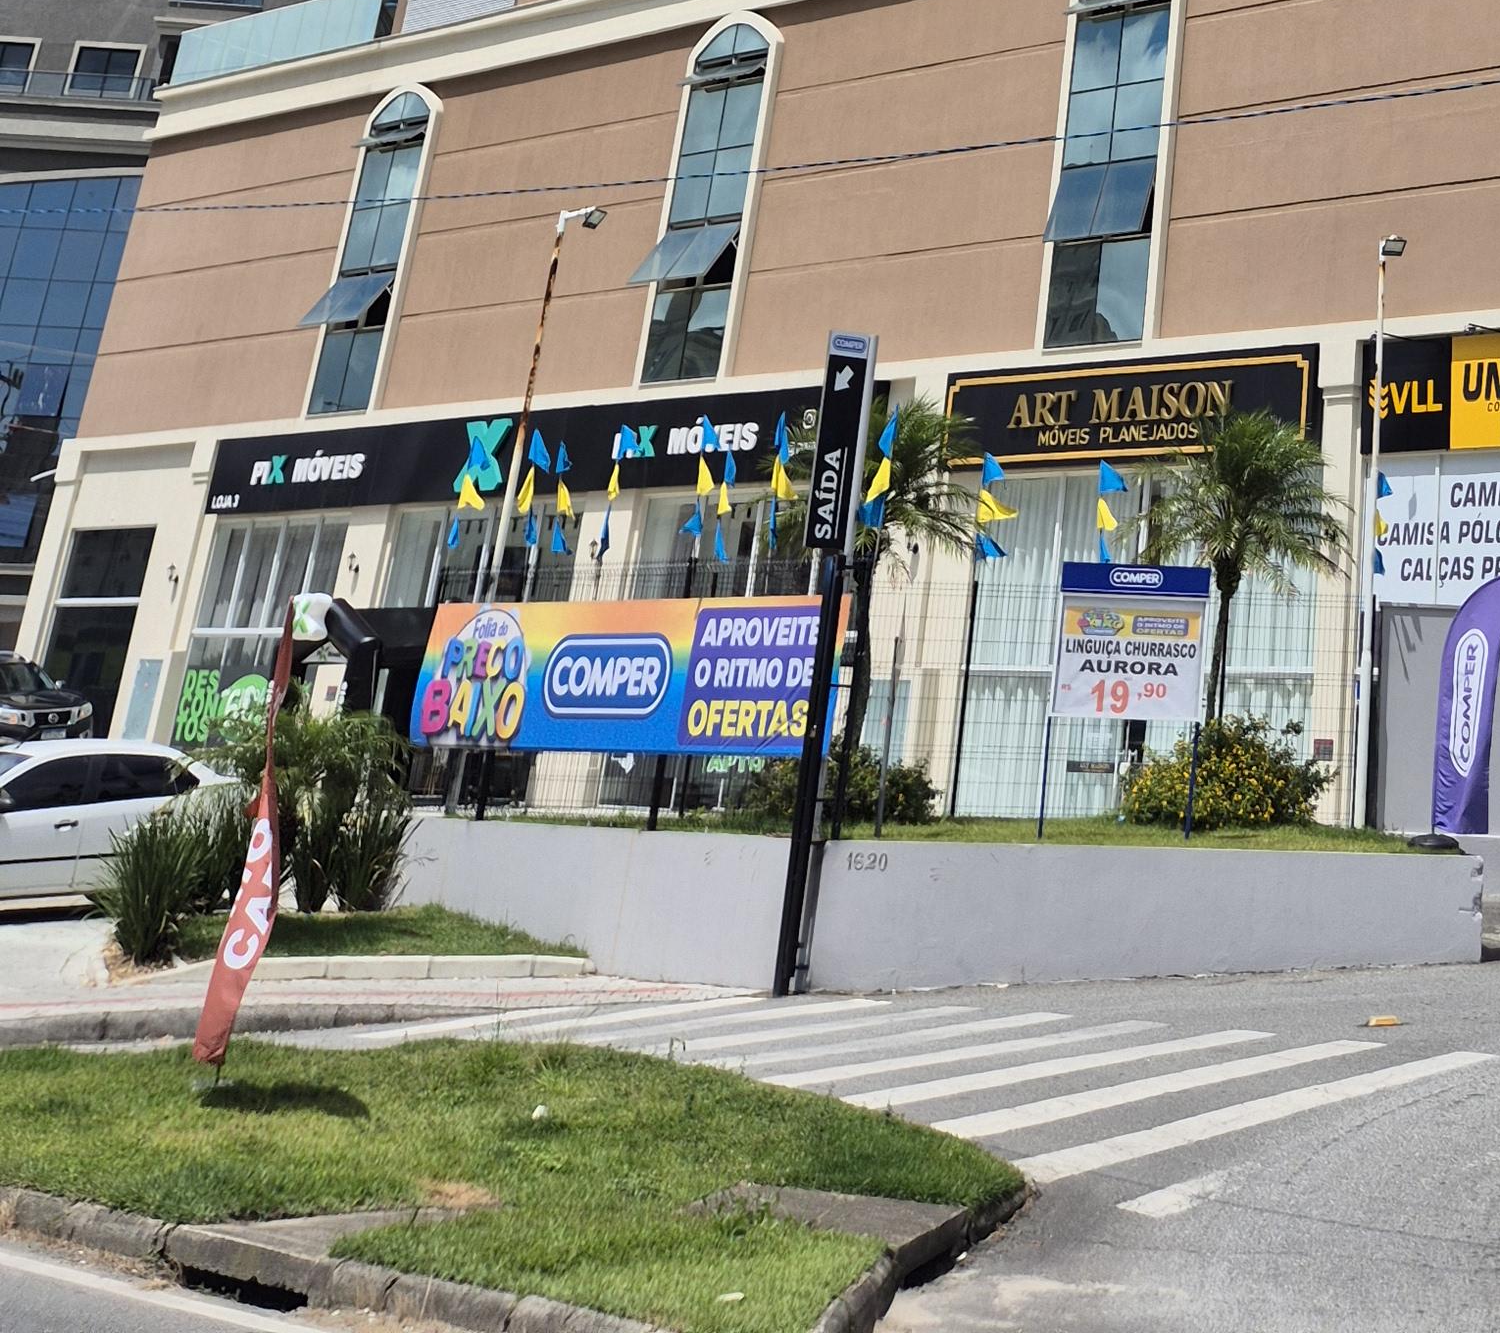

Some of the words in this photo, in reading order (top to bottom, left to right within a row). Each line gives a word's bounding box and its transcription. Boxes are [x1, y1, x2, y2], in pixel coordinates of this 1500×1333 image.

[1007, 389, 1078, 430] ART
[1090, 379, 1234, 425] MAISON
[1389, 379, 1443, 415] VLL
[1037, 424, 1091, 447] MÓVEIS
[1099, 422, 1199, 444] PLANEJADOS
[250, 454, 289, 486] PIX
[291, 449, 366, 483] MÓVEIS
[211, 494, 233, 509] LOJA
[815, 448, 843, 540] SAÍDA
[1113, 571, 1161, 584] COMPER
[1400, 556, 1475, 588] CALÇAS
[473, 617, 497, 639] Folia
[700, 615, 821, 647] APROVEITE
[1065, 638, 1121, 658] LINGUIÇA
[1125, 641, 1197, 659] CHURRASCO
[552, 655, 659, 697] COMPER
[694, 659, 711, 688] O
[714, 658, 782, 688] RITMO
[785, 657, 814, 687] DE
[1079, 659, 1179, 677] AURORA
[421, 678, 525, 740] BAIXO
[1090, 678, 1130, 714] 19
[1460, 643, 1478, 764] COMPER
[687, 699, 809, 738] OFERTAS
[847, 851, 888, 872] 1620
